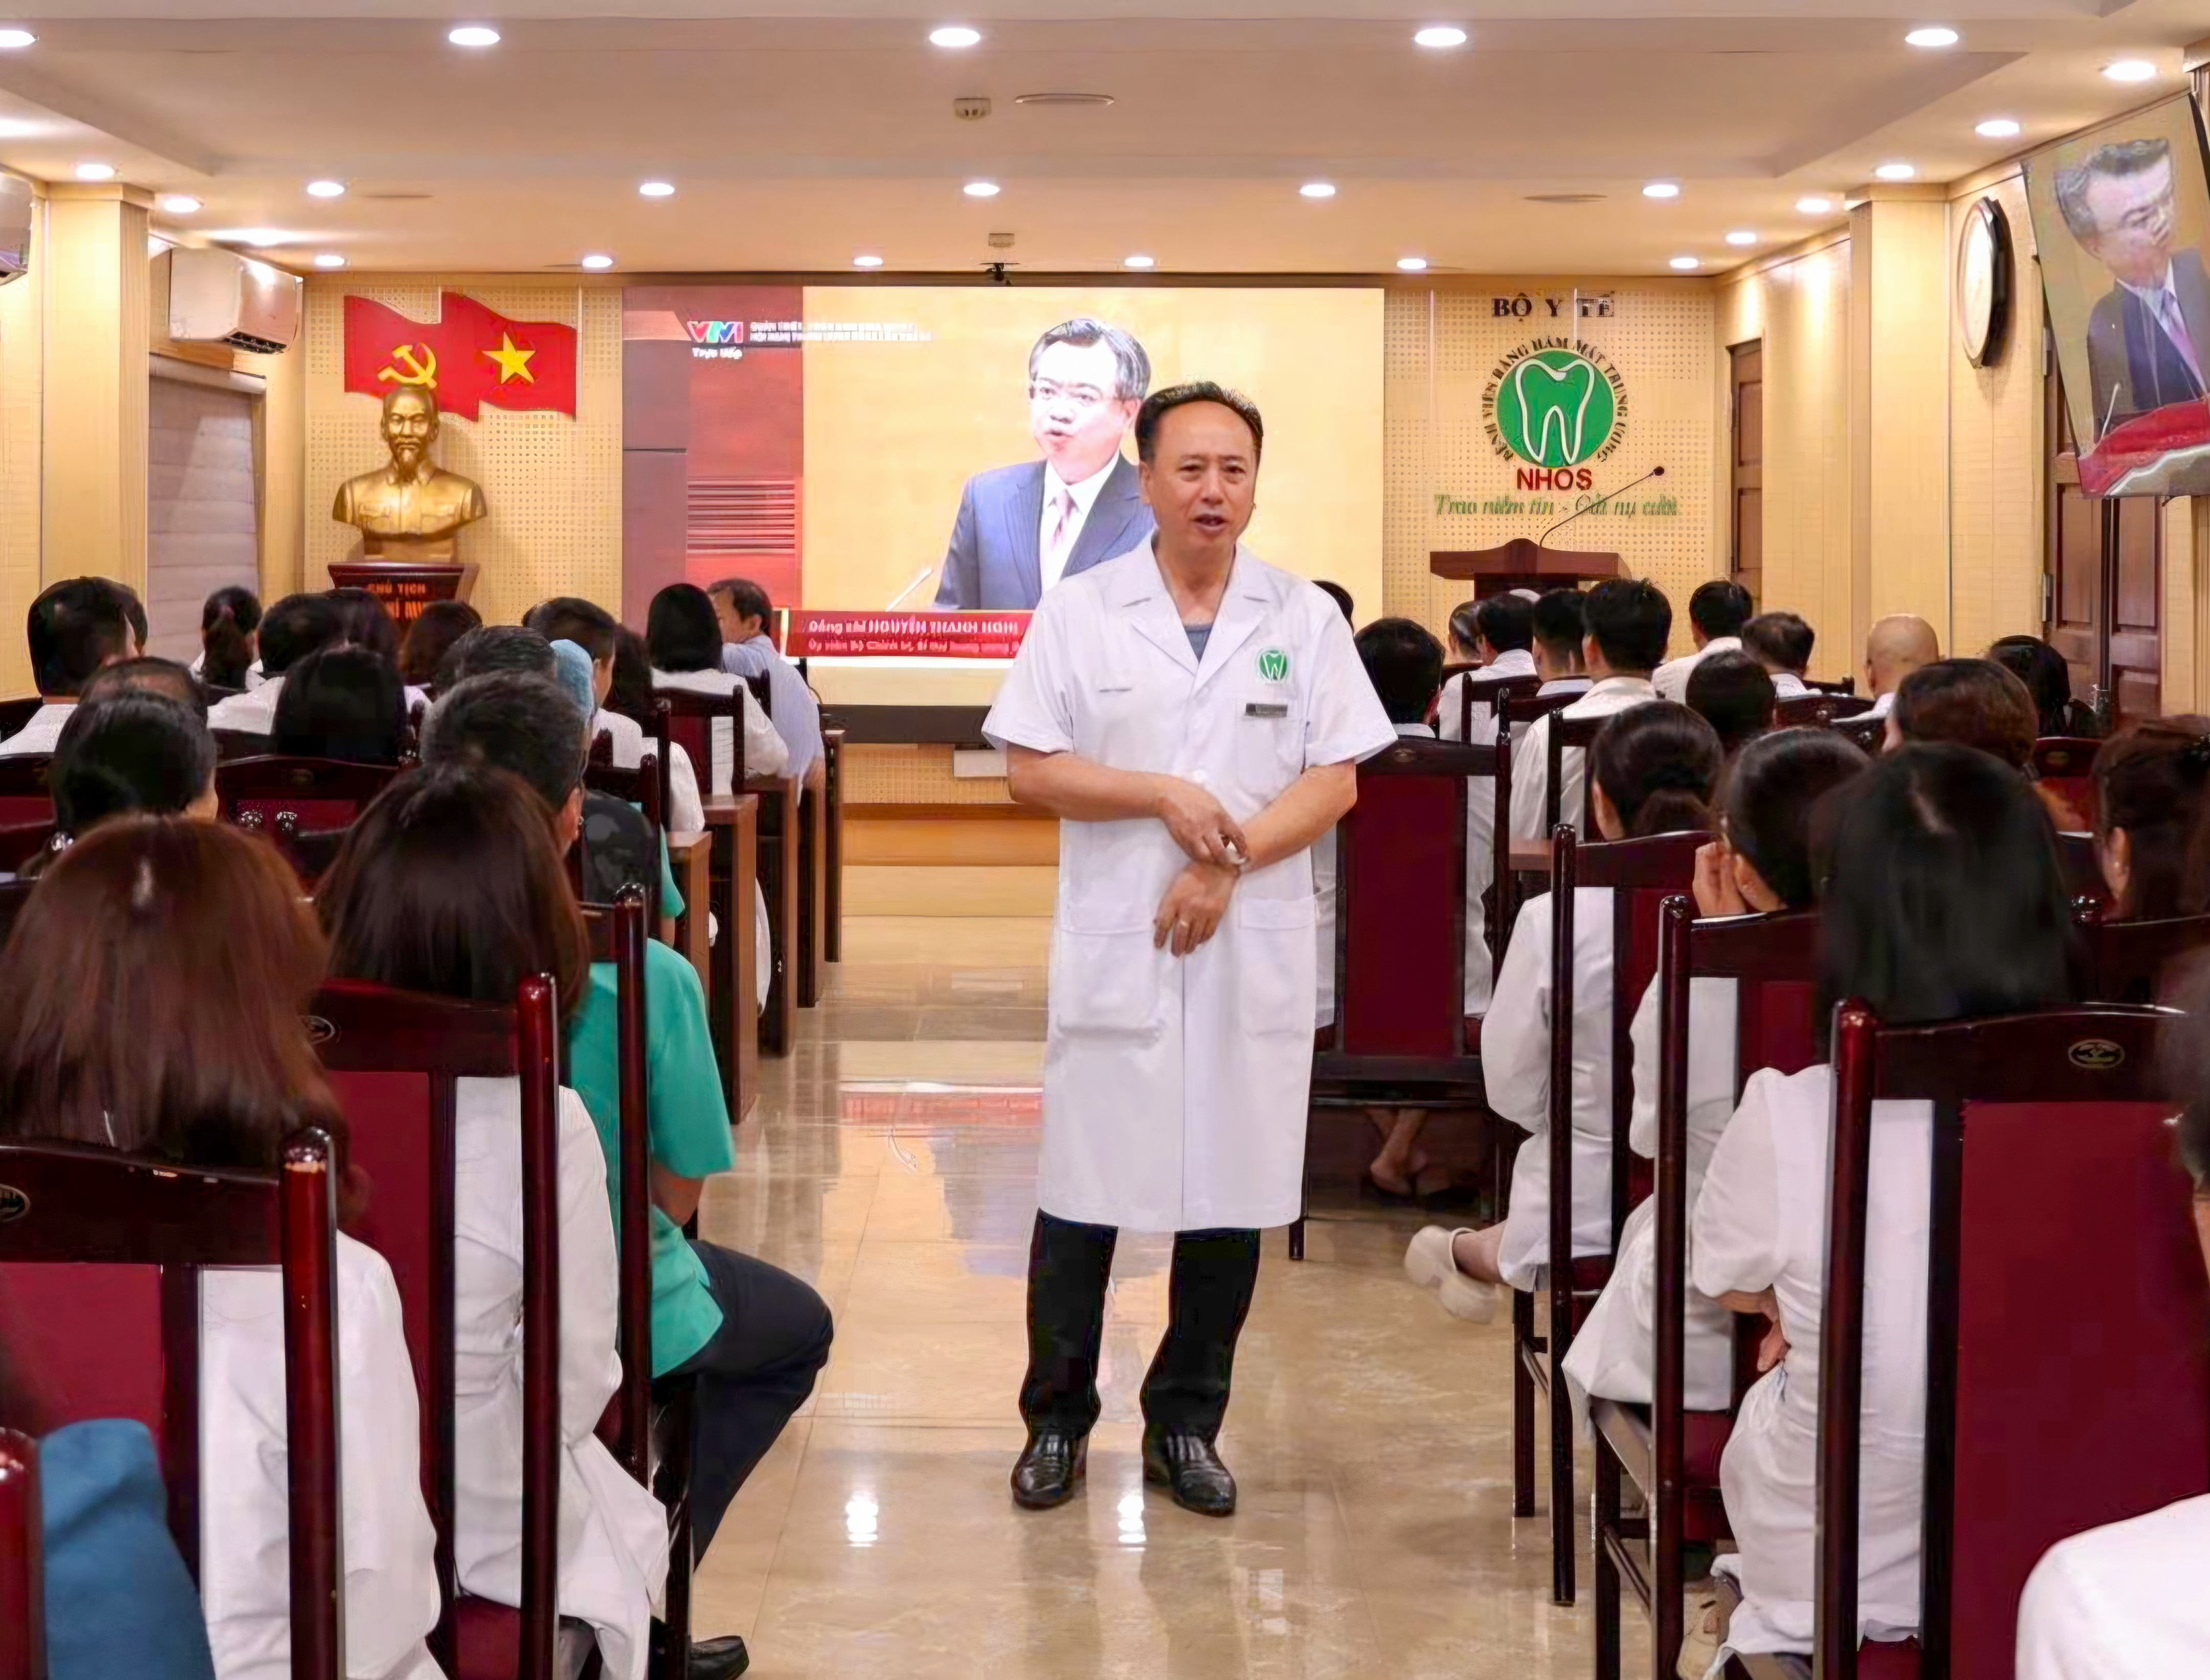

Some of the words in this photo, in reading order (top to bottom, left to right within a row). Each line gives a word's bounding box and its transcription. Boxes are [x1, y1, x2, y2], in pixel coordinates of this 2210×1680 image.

[1492, 292, 1532, 322] BỘ
[1545, 298, 1563, 317] Y
[1517, 468, 1592, 491] NHOS
